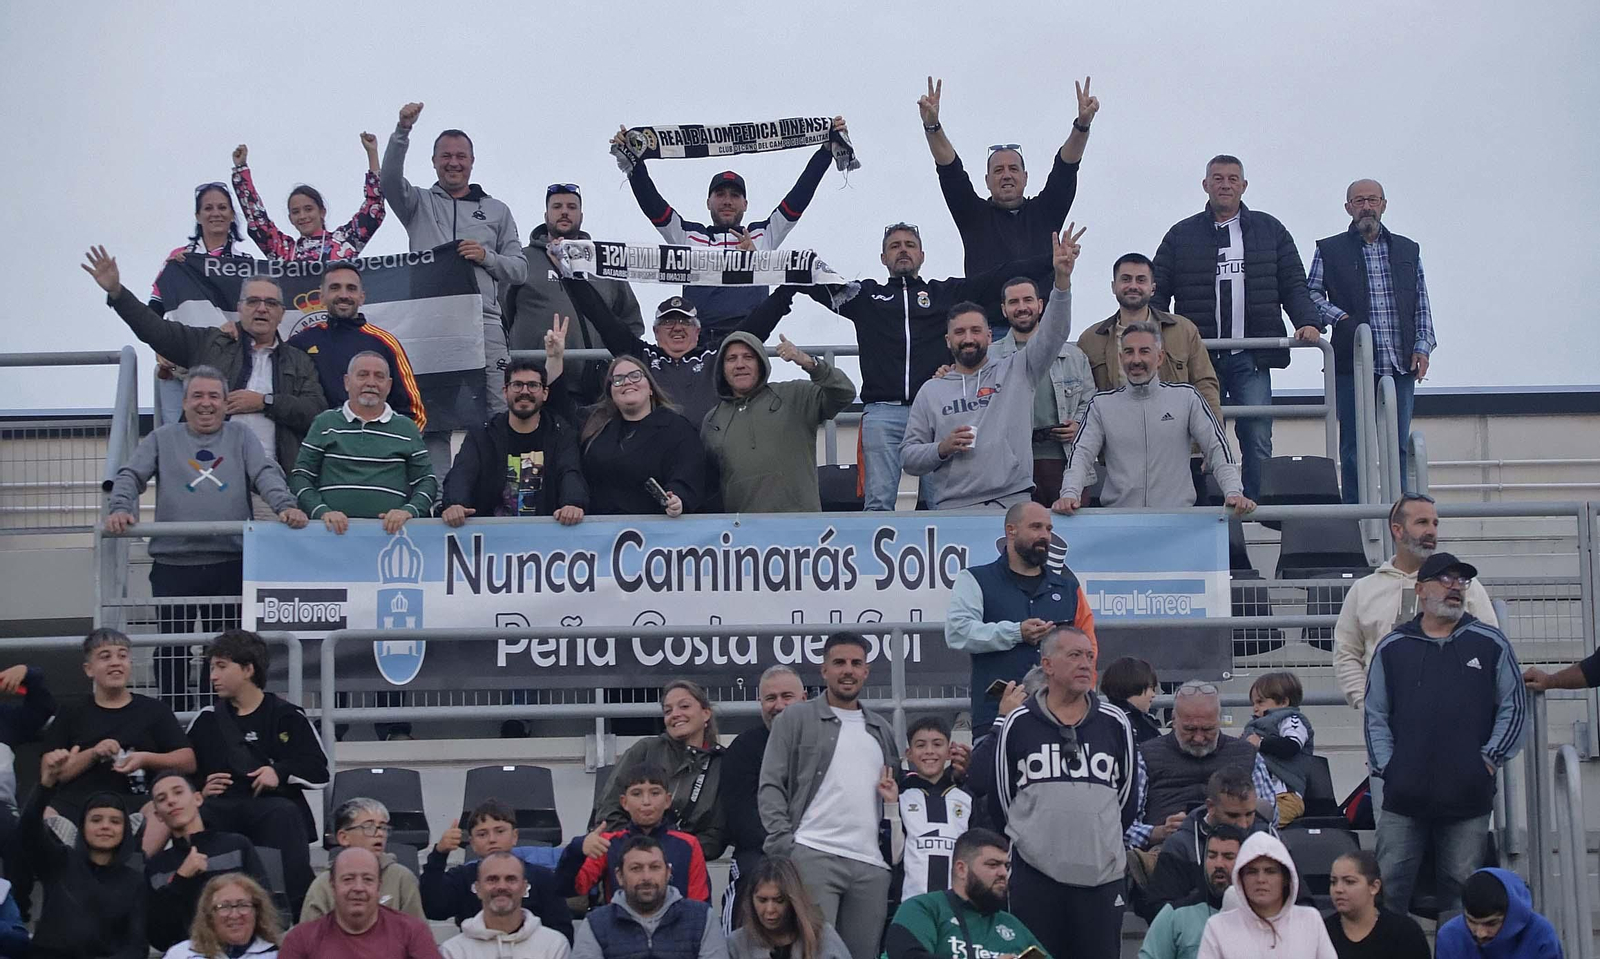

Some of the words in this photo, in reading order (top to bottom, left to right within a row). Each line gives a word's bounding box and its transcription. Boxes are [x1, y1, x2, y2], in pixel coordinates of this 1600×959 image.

[658, 128, 692, 147] REAL
[692, 122, 778, 146] BALOMPEDICA
[779, 117, 829, 137] LINENSE
[718, 145, 733, 153] CLUB
[758, 141, 768, 150] DEL
[204, 257, 259, 277] Real
[268, 249, 435, 278] Balopedica
[1215, 262, 1245, 276] OTUS
[942, 395, 992, 416] elles
[445, 533, 597, 596] Nunca
[611, 526, 858, 593] Caminarás
[873, 526, 968, 591] Sola
[263, 597, 341, 623] Balona
[1099, 589, 1127, 615] La
[1133, 589, 1191, 615] Línea
[496, 612, 616, 667] Peña
[632, 610, 758, 666] Costa
[916, 839, 953, 850] LOTU
